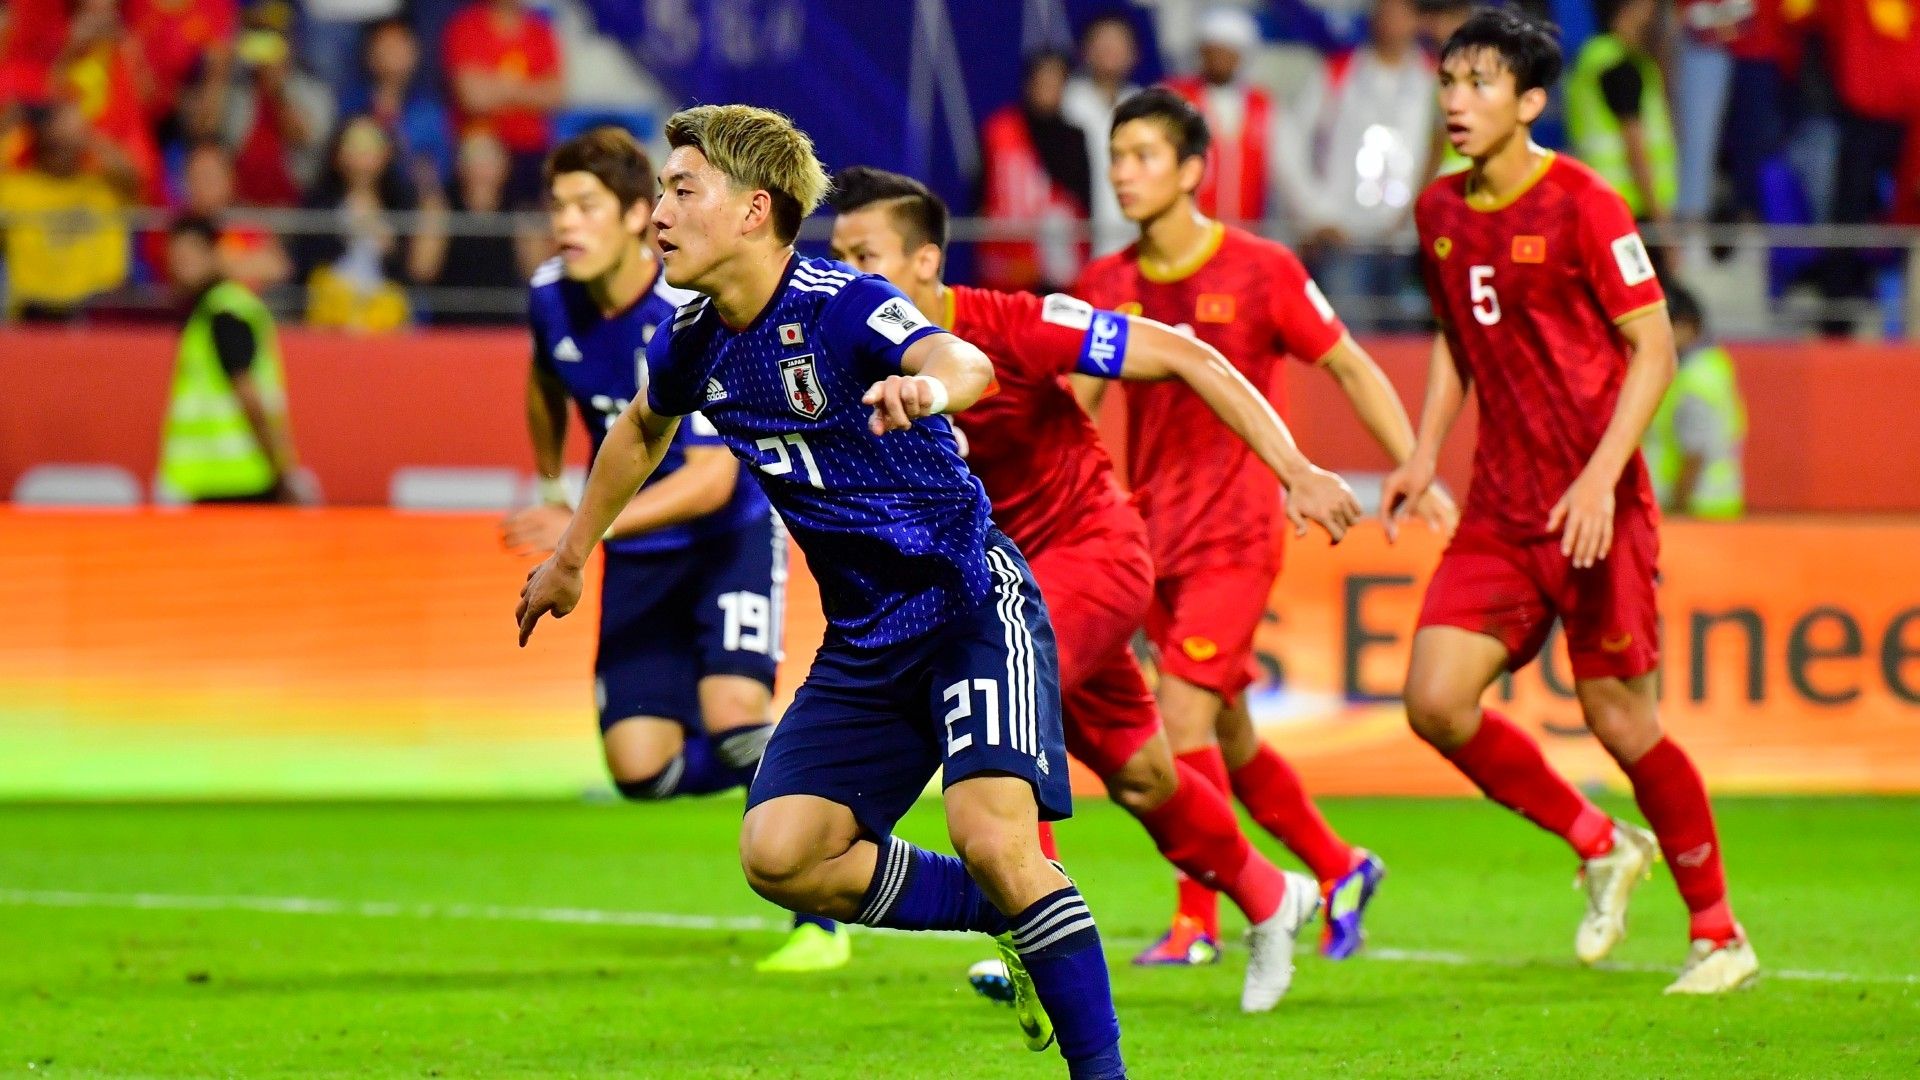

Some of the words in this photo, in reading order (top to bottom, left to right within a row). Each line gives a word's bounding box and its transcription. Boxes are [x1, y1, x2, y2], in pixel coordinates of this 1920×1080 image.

[1470, 265, 1501, 325] 5
[787, 358, 806, 368] JAPAN
[1088, 313, 1118, 374] AFC
[755, 432, 826, 490] 21
[717, 590, 769, 655] 19
[943, 678, 1000, 757] 21
